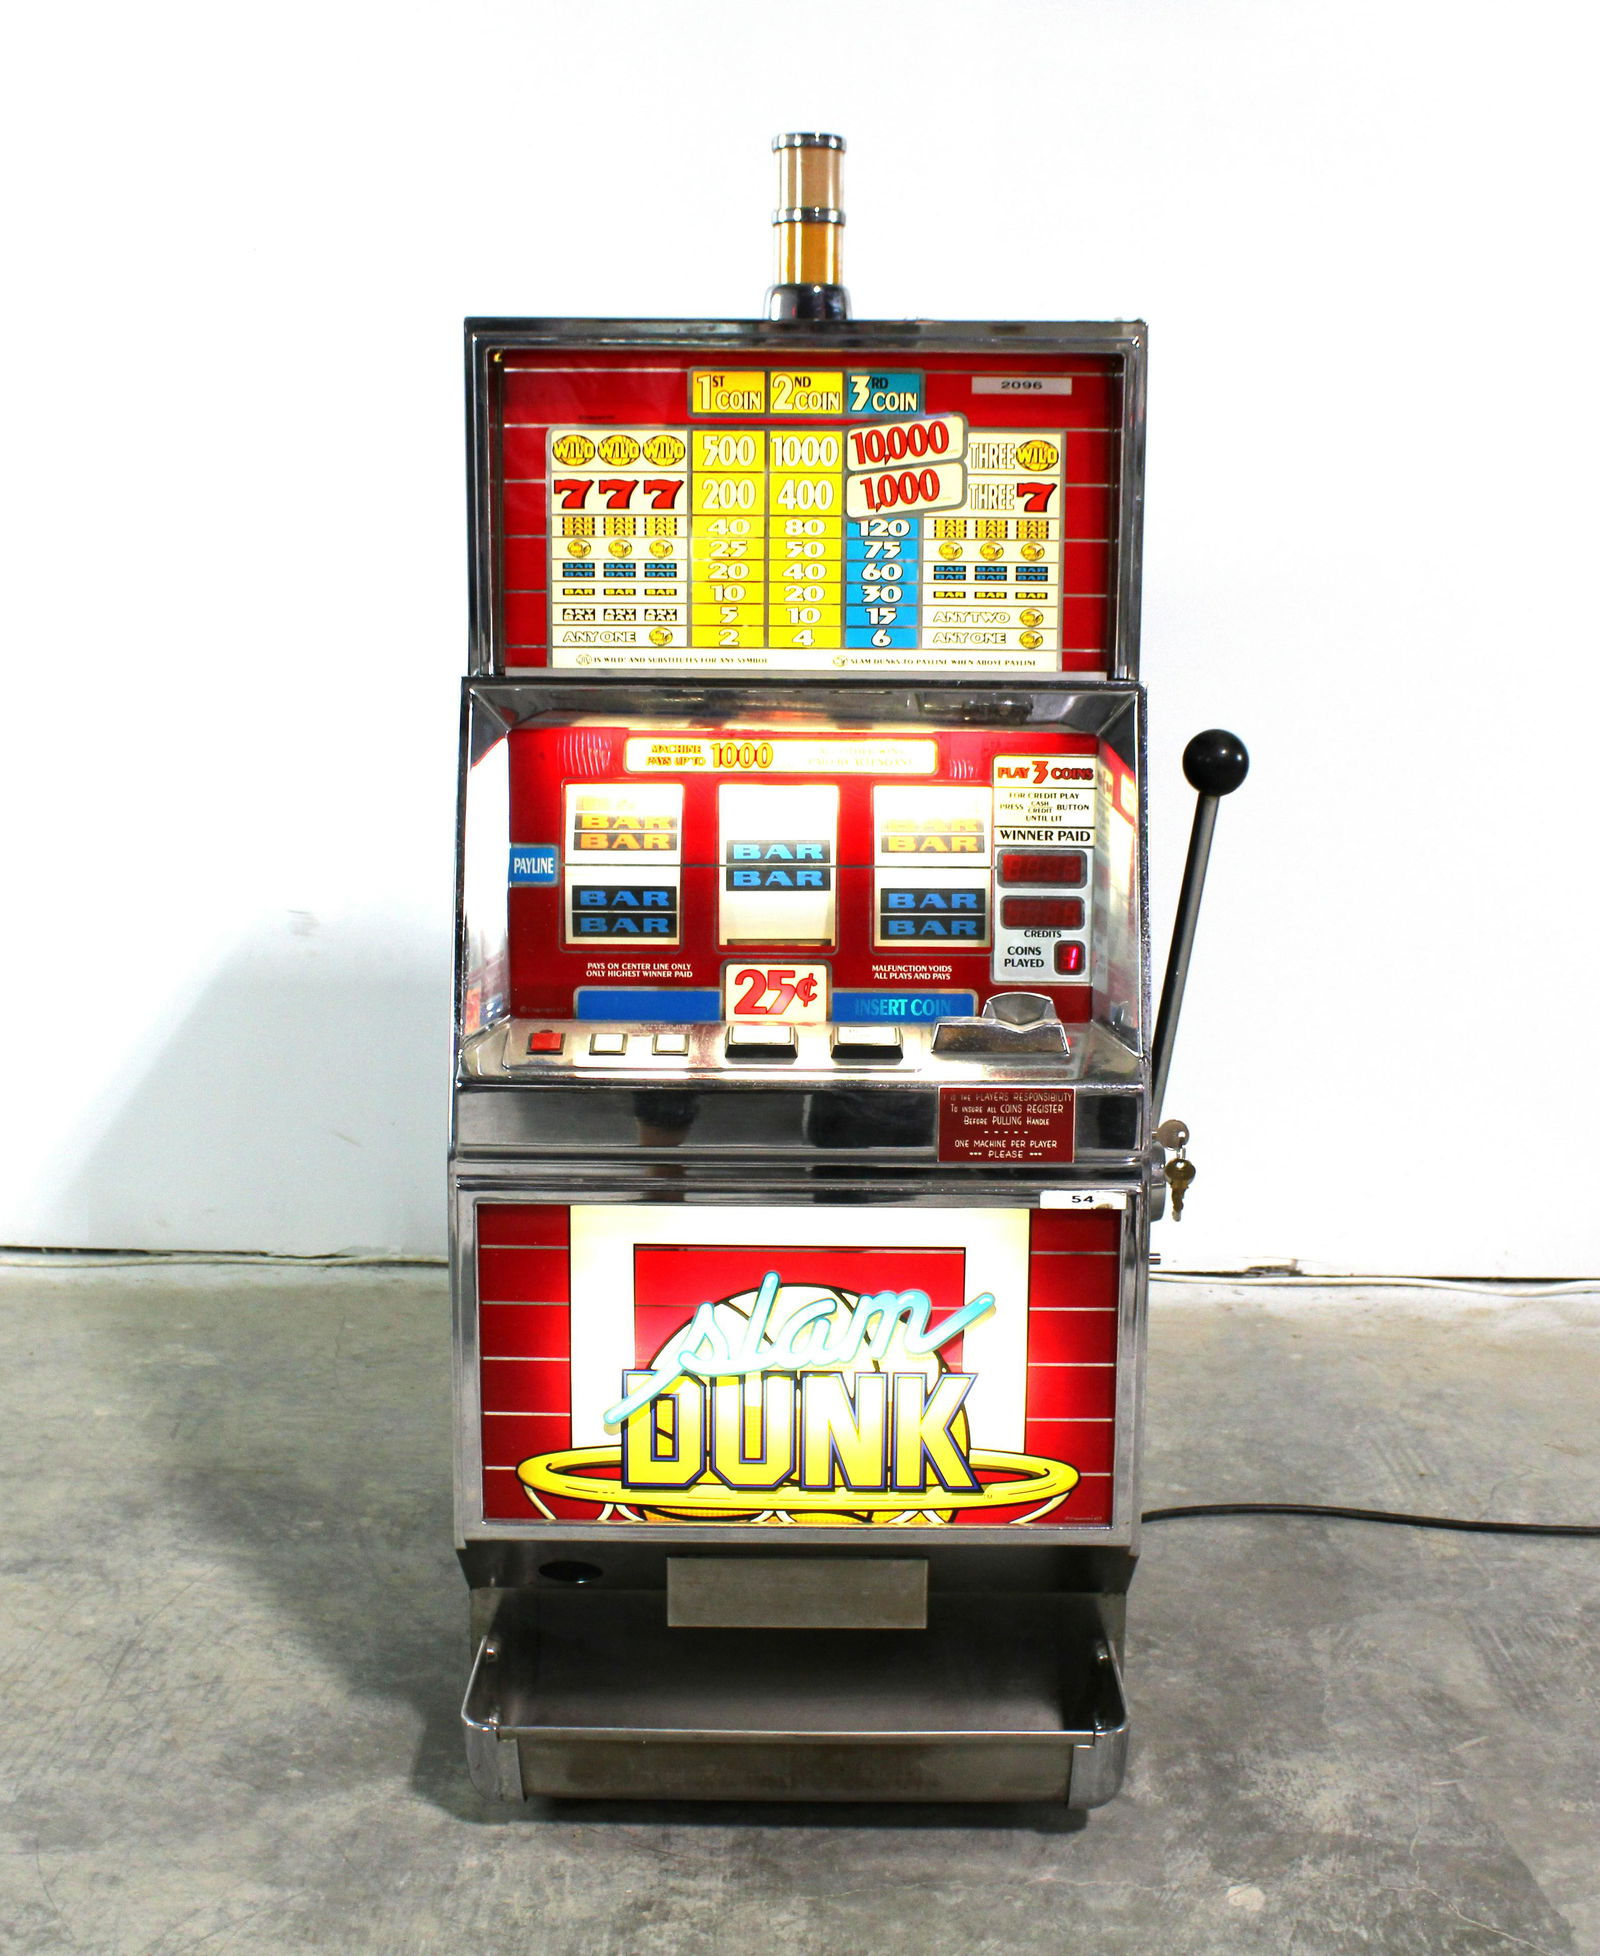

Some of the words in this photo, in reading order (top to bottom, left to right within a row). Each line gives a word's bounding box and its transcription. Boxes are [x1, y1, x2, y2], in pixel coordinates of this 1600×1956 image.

[1001, 380, 1042, 390] 2096
[716, 391, 762, 411] COIN
[794, 391, 840, 411] COIN
[872, 392, 917, 412] COIN
[703, 435, 756, 467] 500
[771, 435, 839, 468] 1000
[850, 421, 949, 466] 10,000
[969, 443, 1015, 470] THREE
[554, 479, 594, 509] 7
[599, 479, 639, 509] 7
[644, 479, 684, 509] 7
[702, 479, 756, 510] 200
[778, 479, 833, 510] 400
[860, 468, 940, 512] 1,000
[969, 484, 1014, 510] THREE
[1017, 482, 1057, 512] 7
[707, 518, 751, 536] 40
[784, 519, 826, 537] 80
[859, 518, 911, 537] 120
[709, 540, 748, 558] 25
[785, 541, 826, 558] 50
[864, 540, 901, 559] 75
[708, 563, 750, 580] 20
[782, 563, 826, 580] 40
[861, 563, 903, 581] 60
[710, 584, 746, 602] 10
[784, 585, 826, 602] 20
[861, 585, 903, 604] 30
[720, 606, 739, 624] 5
[786, 607, 821, 624] 10
[865, 606, 898, 625] 15
[933, 611, 970, 622] ANY
[970, 612, 1010, 623] TWO
[563, 631, 599, 642] ANY
[600, 631, 636, 642] ONE
[719, 628, 739, 646] 2
[792, 629, 815, 646] 4
[871, 628, 892, 647] 6
[933, 632, 969, 643] ANY
[970, 632, 1006, 644] ONE
[710, 742, 773, 768] 1000
[998, 767, 1030, 779] PLAY
[1032, 760, 1049, 784] 3
[1051, 767, 1094, 780] COINS
[1059, 792, 1079, 800] PLAY
[581, 815, 671, 829] BAR
[580, 833, 671, 849] BAR
[888, 836, 979, 852] BAR
[1000, 830, 1054, 841] WINNER
[1058, 830, 1091, 842] PAID
[733, 844, 824, 860] BAR
[513, 857, 554, 874] PAYLINE
[733, 870, 824, 886] BAR
[580, 890, 670, 906] BAR
[888, 893, 978, 909] BAR
[580, 917, 670, 933] BAR
[888, 920, 978, 936] BAR
[1024, 930, 1062, 938] CREDITS
[1007, 946, 1041, 956] COINS
[1069, 946, 1078, 969] 1
[1004, 958, 1044, 968] PLAYED
[734, 968, 818, 1015] 25¢
[855, 999, 908, 1016] INSERT
[910, 999, 950, 1016] COIN
[1013, 1092, 1072, 1102] RESPONSIBILITY
[1000, 1104, 1022, 1114] COINS
[1026, 1104, 1064, 1114] REGISTER
[992, 1116, 1022, 1126] PULLING
[955, 1140, 969, 1148] ONE
[973, 1140, 1006, 1148] MACHINE
[1011, 1140, 1025, 1148] PER
[1029, 1140, 1057, 1148] PLAYER
[988, 1150, 1023, 1159] PLEASE
[1071, 1195, 1094, 1203] 54
[622, 1368, 984, 1492] DUNK
